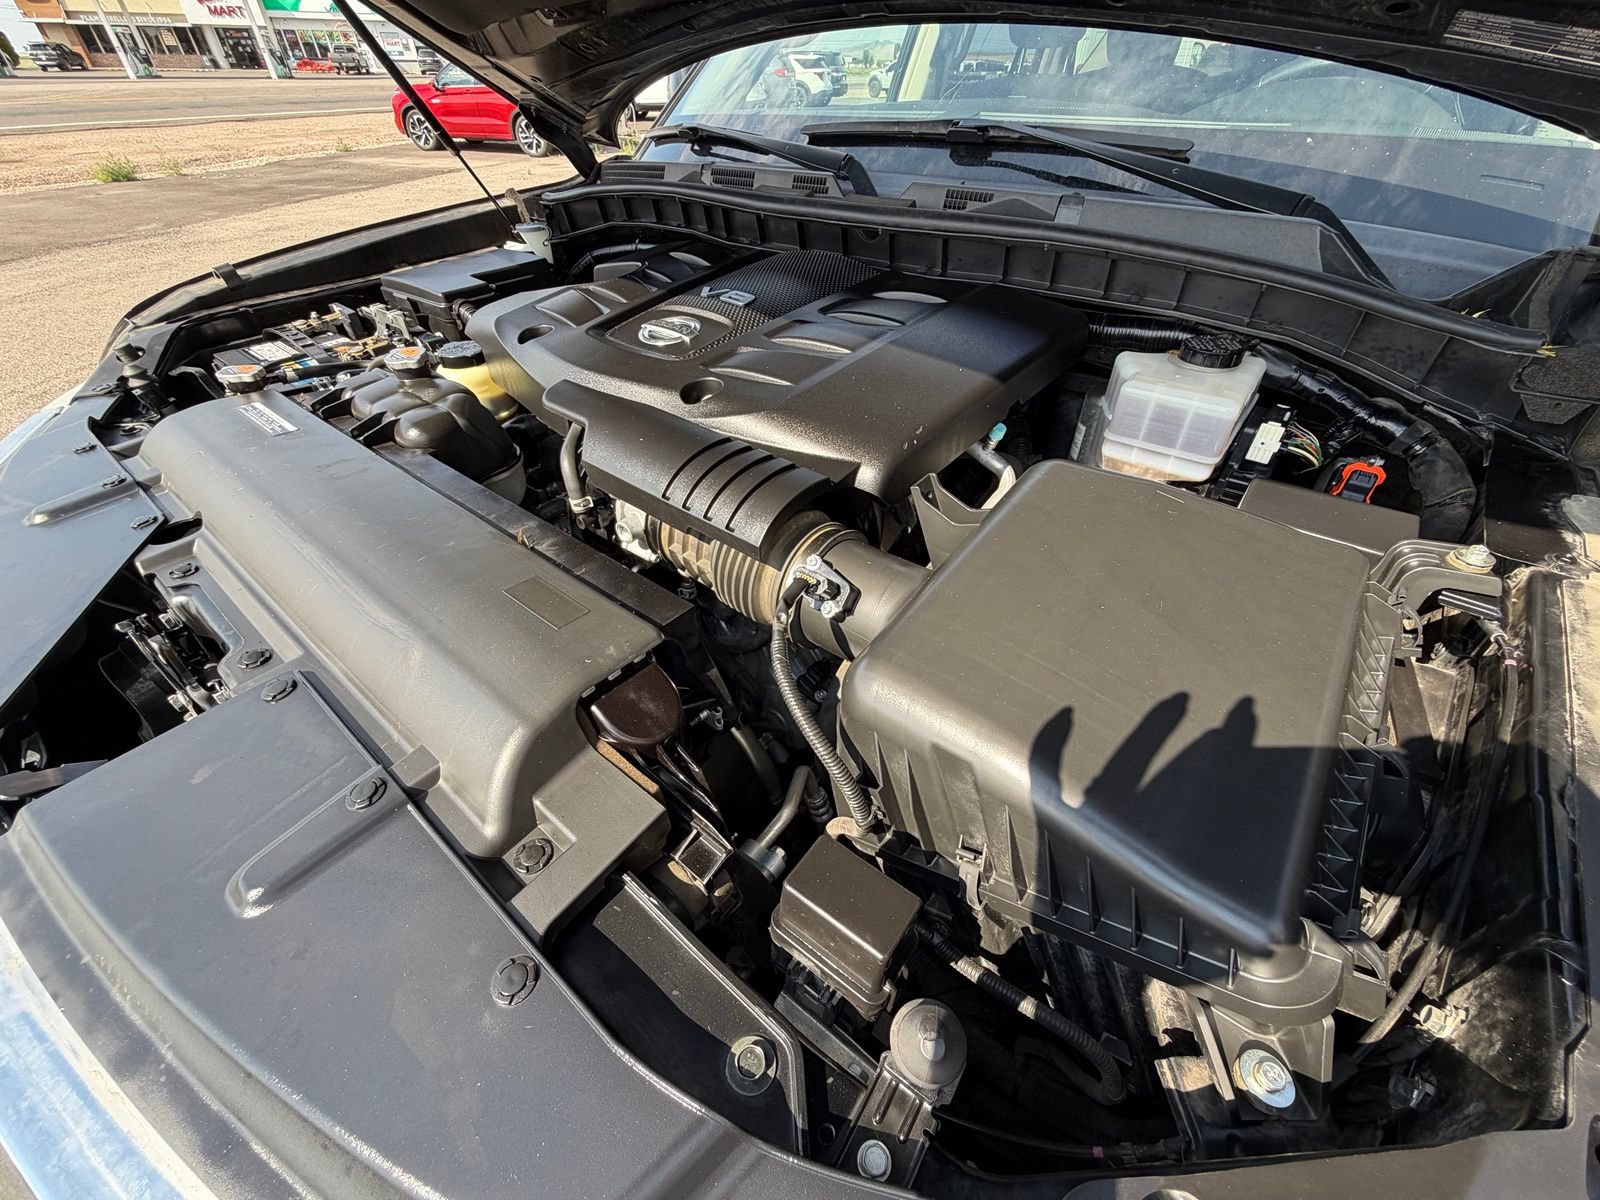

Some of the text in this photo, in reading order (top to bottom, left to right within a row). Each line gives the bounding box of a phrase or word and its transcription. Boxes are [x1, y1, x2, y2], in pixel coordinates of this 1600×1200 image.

[80, 14, 103, 22] FLAM
[206, 5, 246, 18] MART
[700, 286, 756, 306] V8
